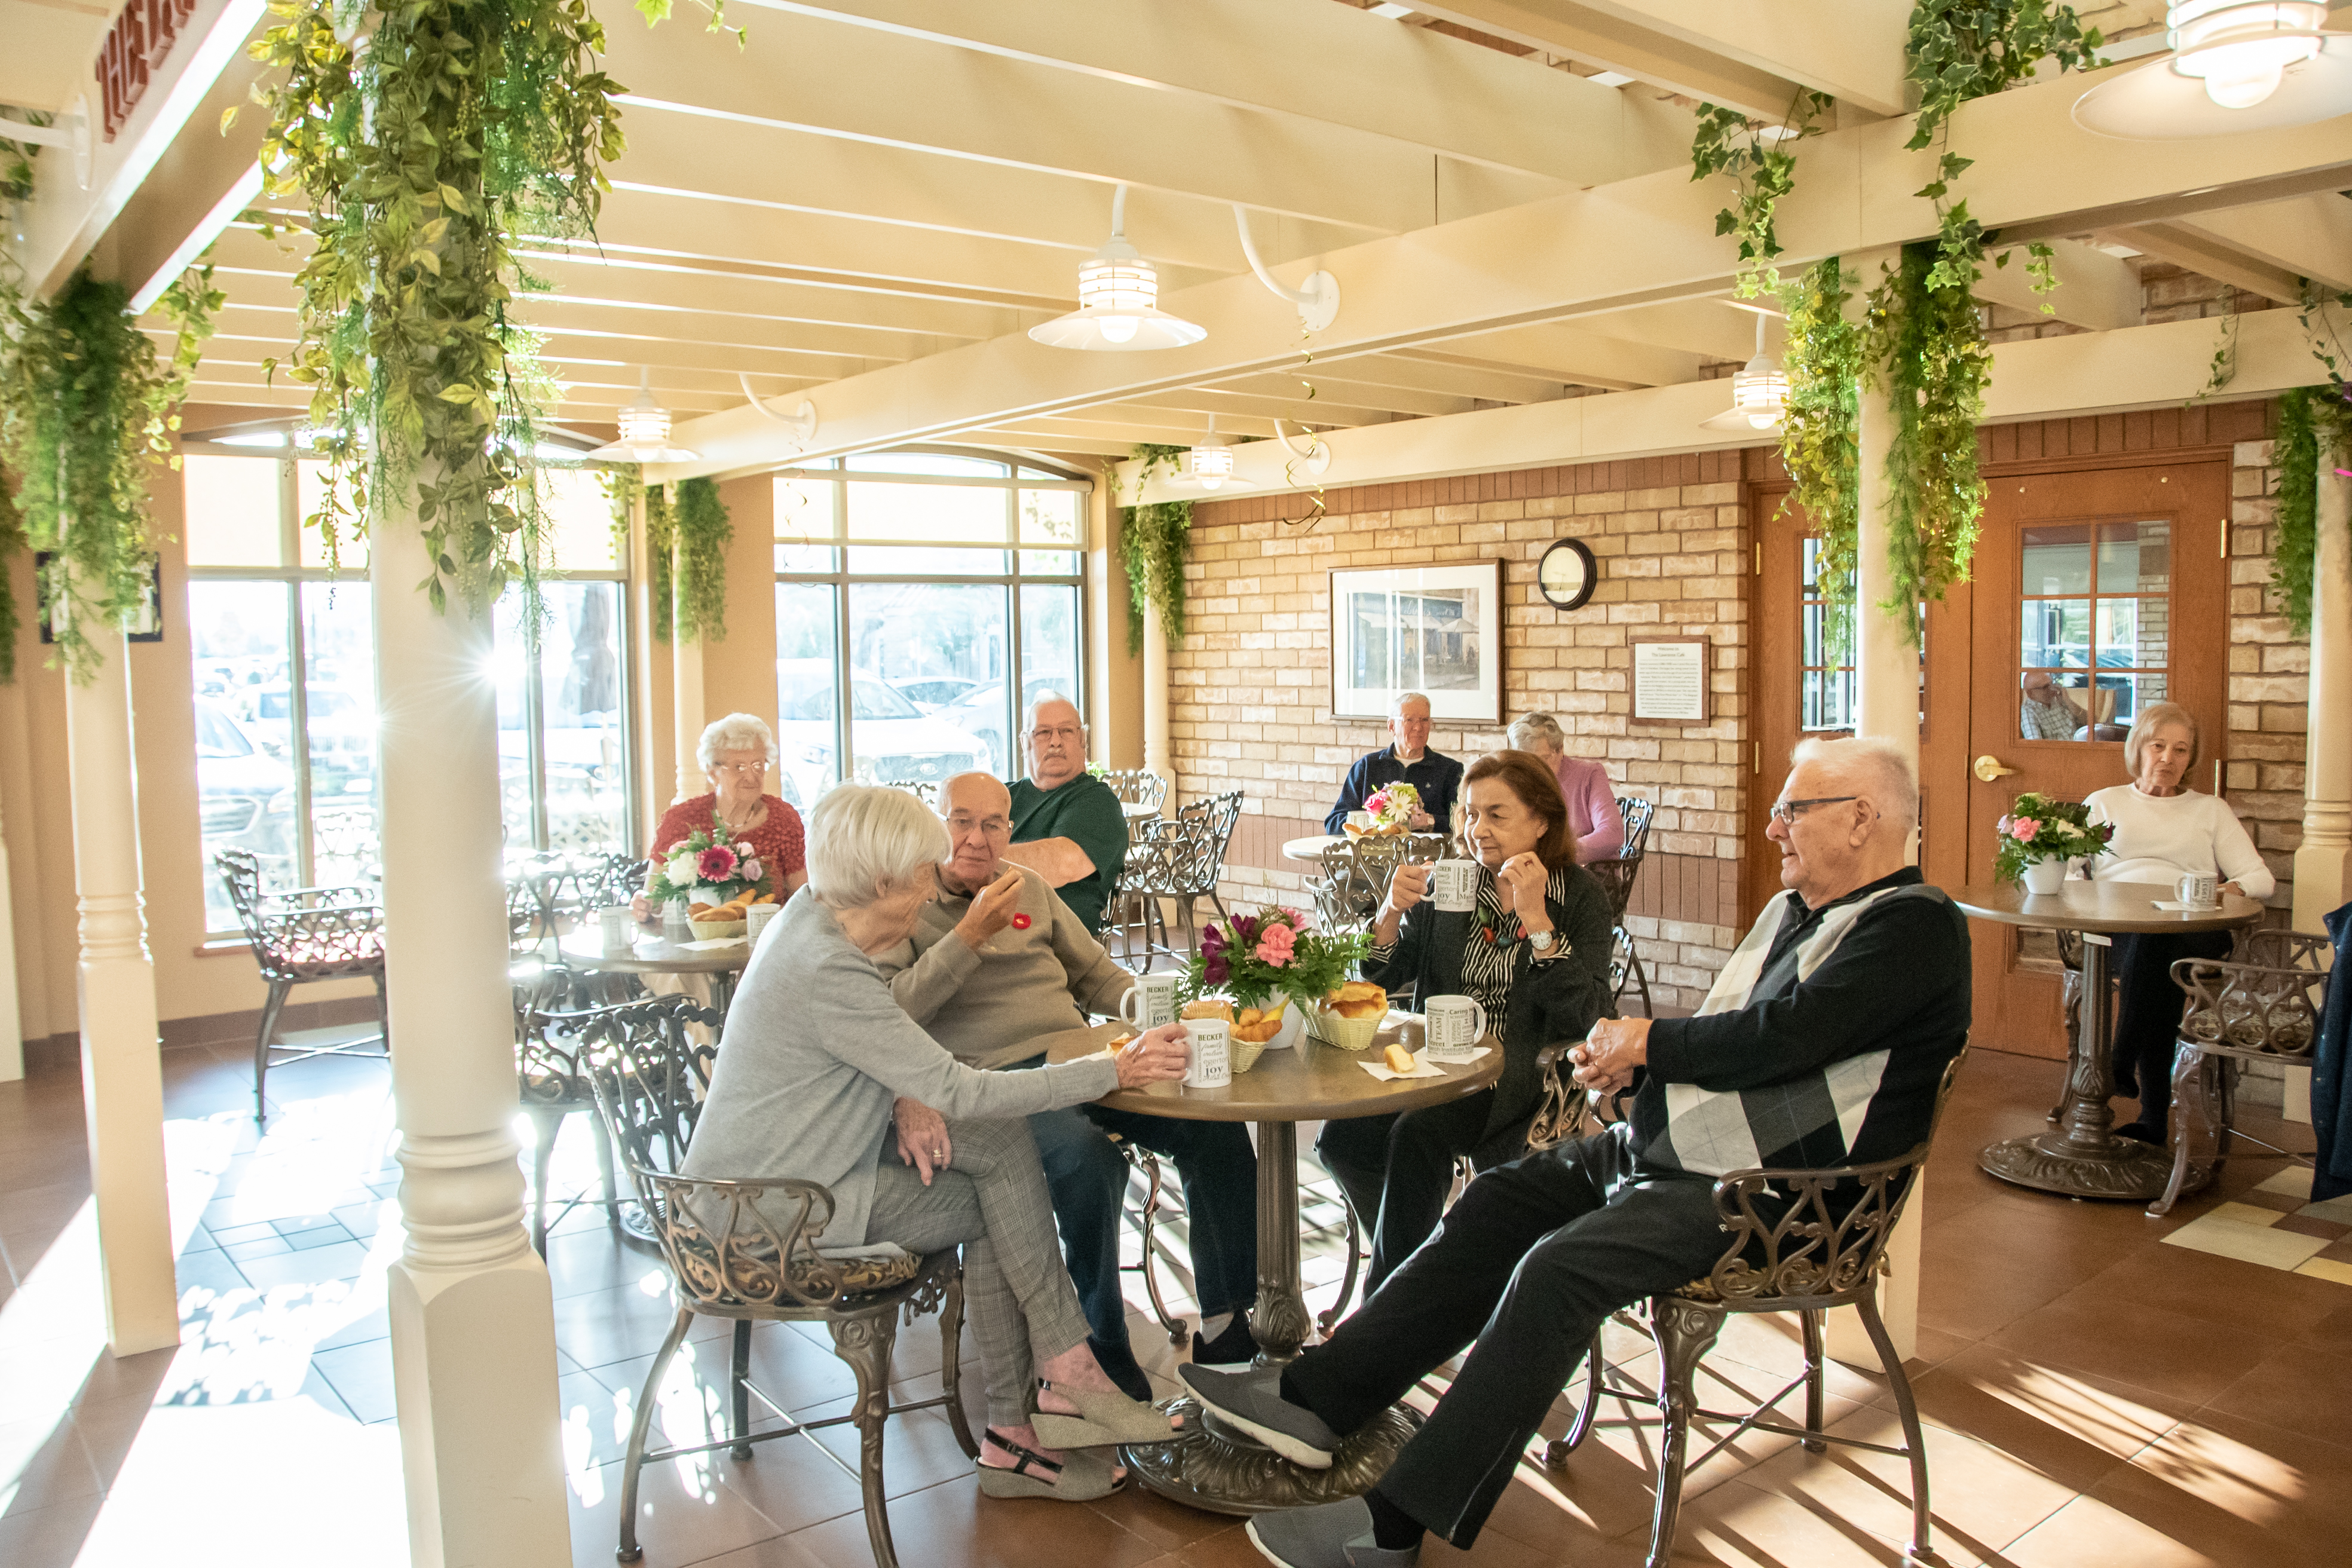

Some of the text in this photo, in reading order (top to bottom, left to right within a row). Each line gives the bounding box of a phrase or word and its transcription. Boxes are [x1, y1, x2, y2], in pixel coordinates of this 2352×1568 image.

[1153, 1013, 1169, 1024] joy
[1201, 1041, 1223, 1051] family
[1205, 1064, 1223, 1076] joy
